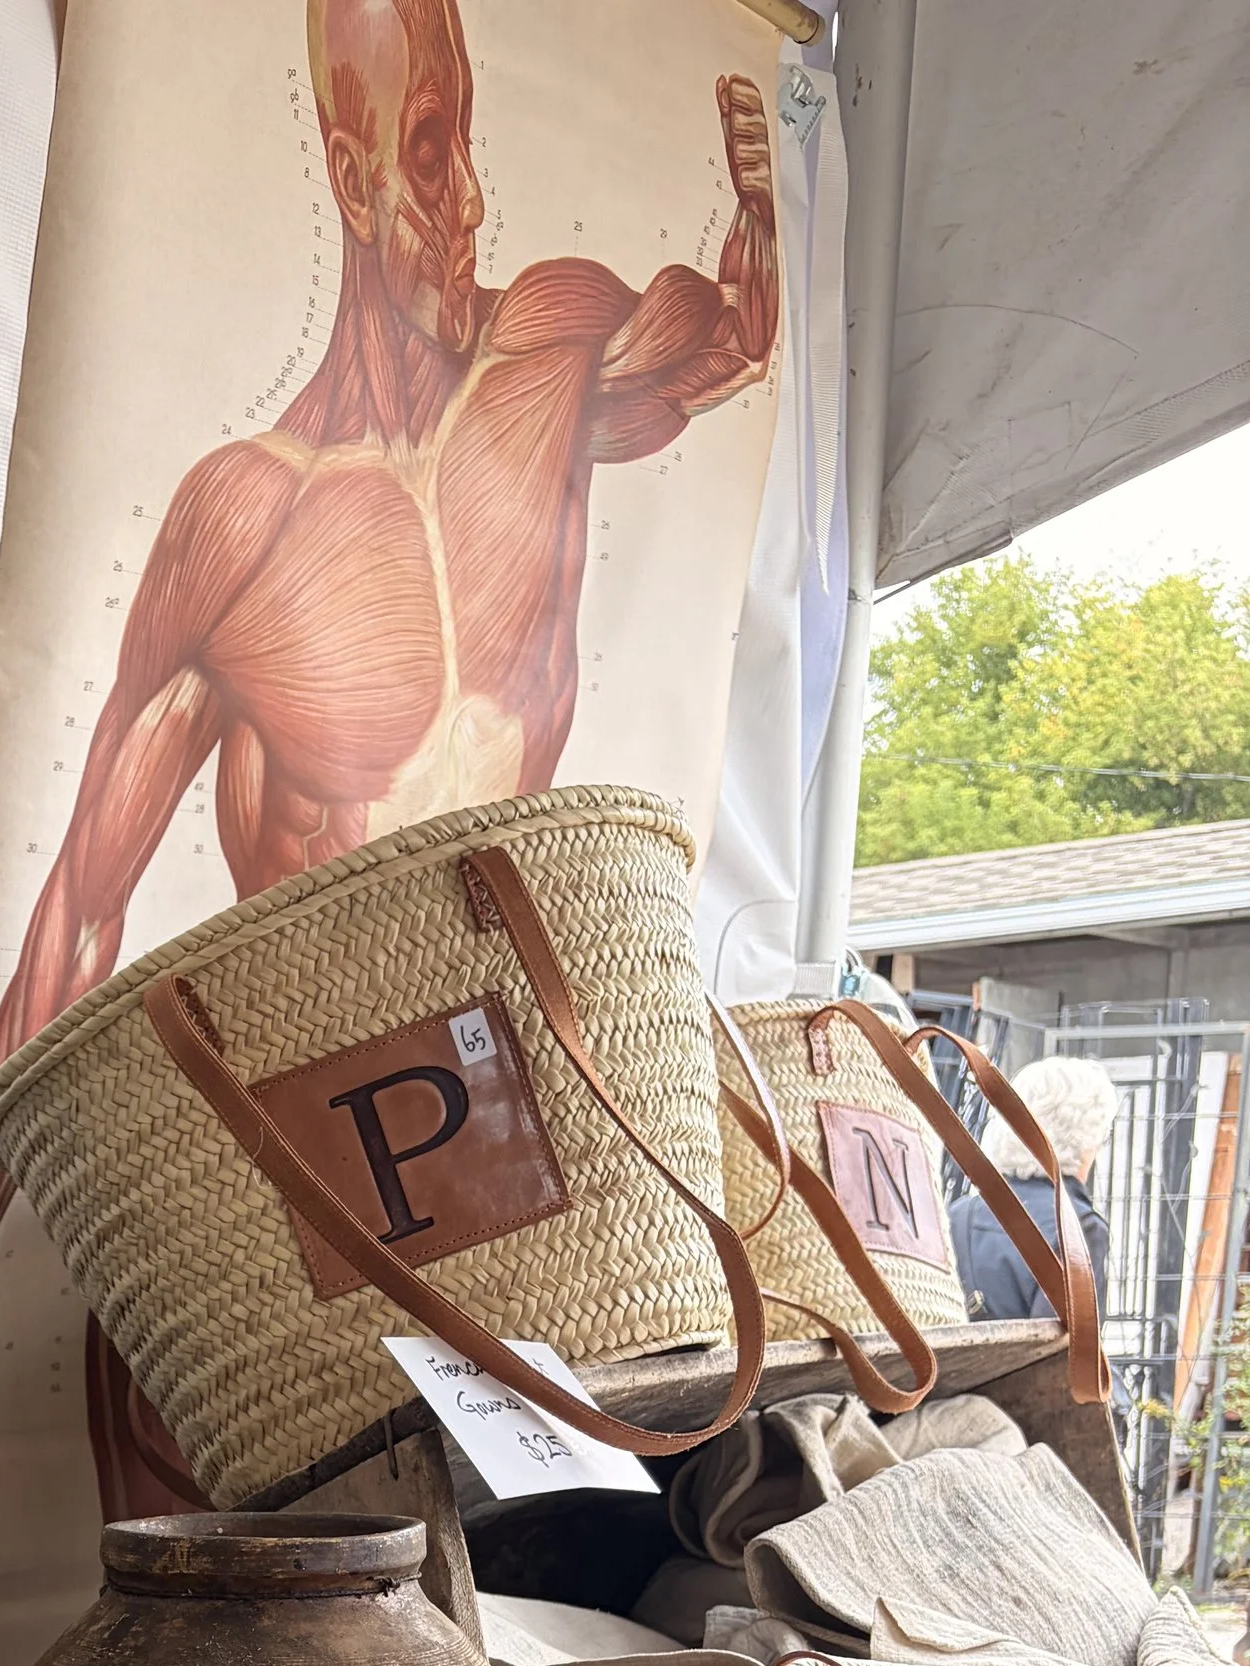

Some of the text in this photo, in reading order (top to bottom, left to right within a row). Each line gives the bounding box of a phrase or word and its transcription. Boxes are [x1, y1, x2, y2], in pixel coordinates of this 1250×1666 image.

[300, 140, 308, 152] 10
[460, 1024, 486, 1053] 65
[328, 1065, 470, 1246] P
[853, 1126, 919, 1240] N
[456, 1391, 522, 1422] Gowns
[516, 1431, 573, 1469] $25
